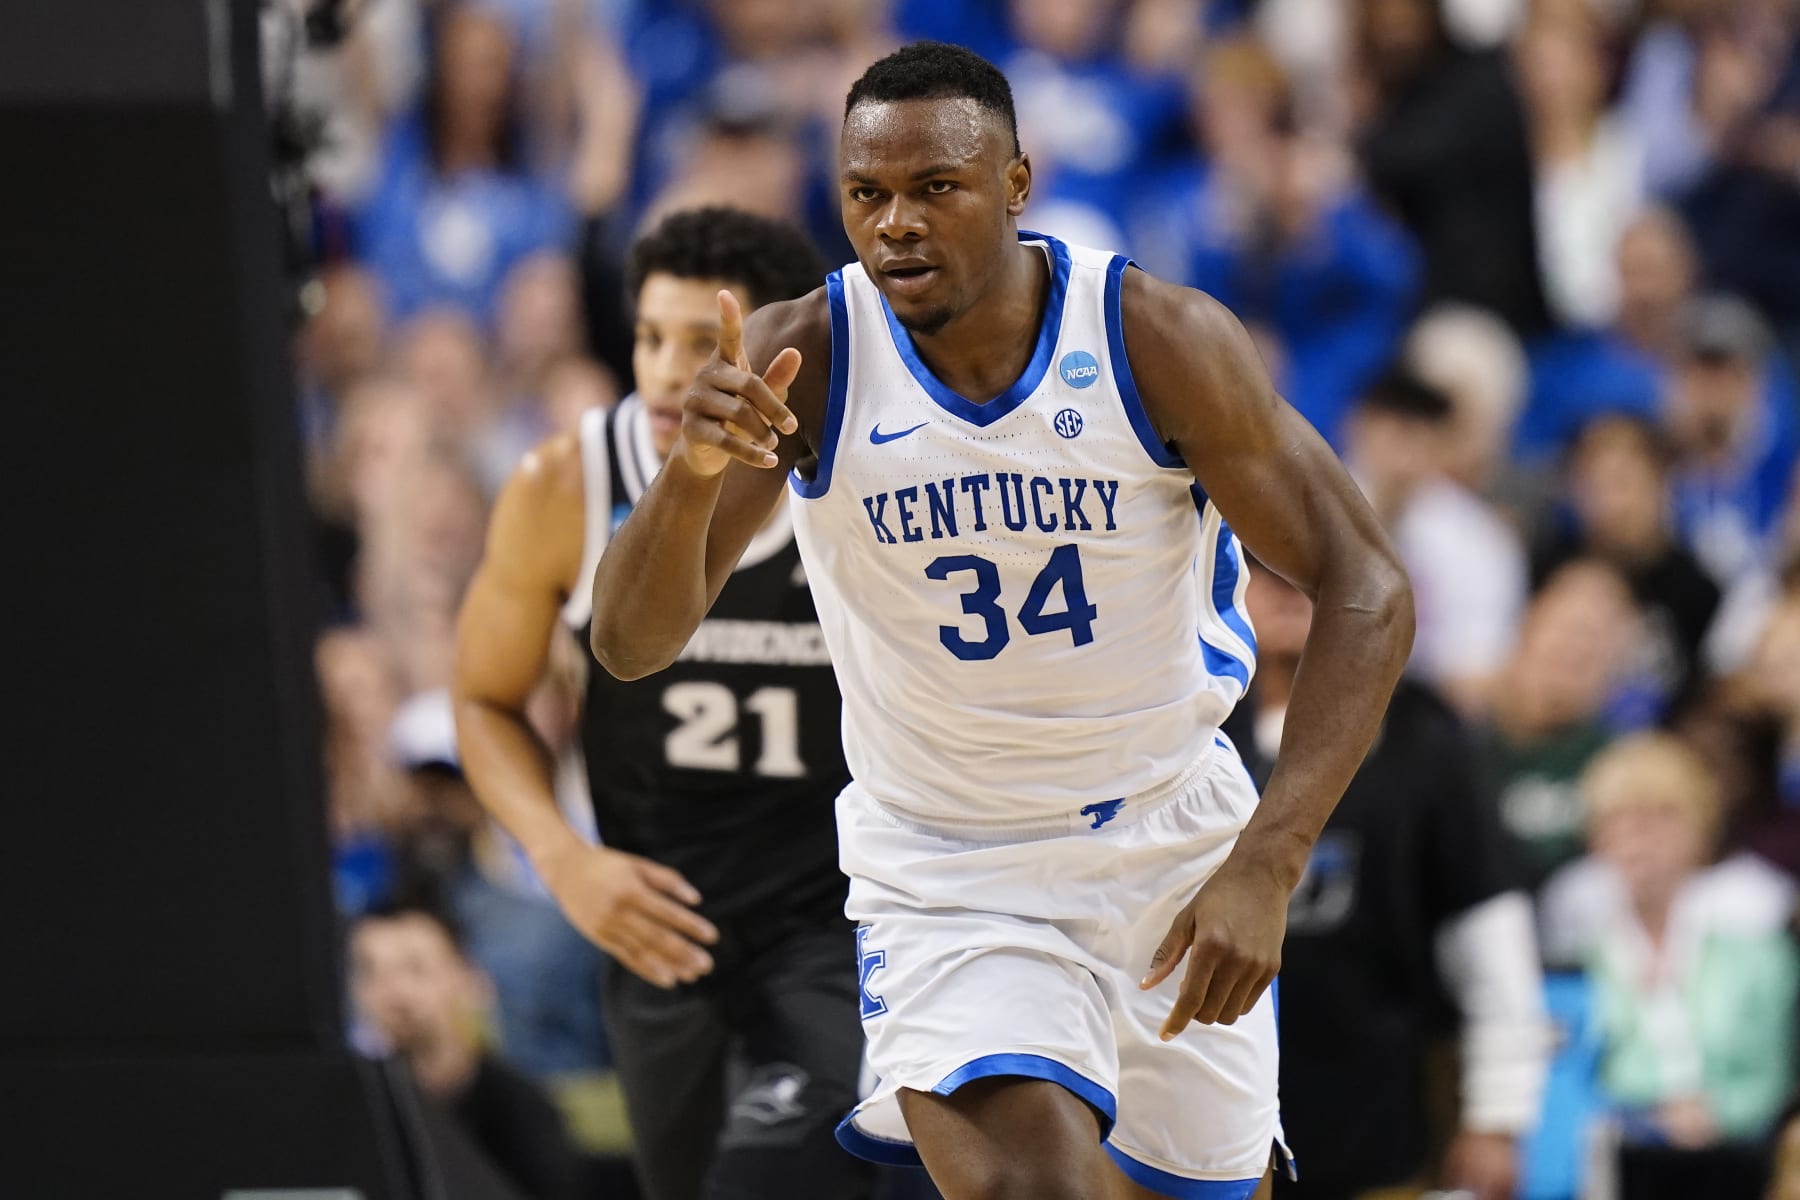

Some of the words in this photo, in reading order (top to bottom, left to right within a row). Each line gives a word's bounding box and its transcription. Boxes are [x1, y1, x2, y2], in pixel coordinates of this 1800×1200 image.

[1067, 365, 1098, 380] NCAA
[1055, 410, 1082, 437] SEC
[863, 472, 1119, 544] KENTUCKY
[924, 543, 1098, 661] 34
[662, 681, 805, 777] 21
